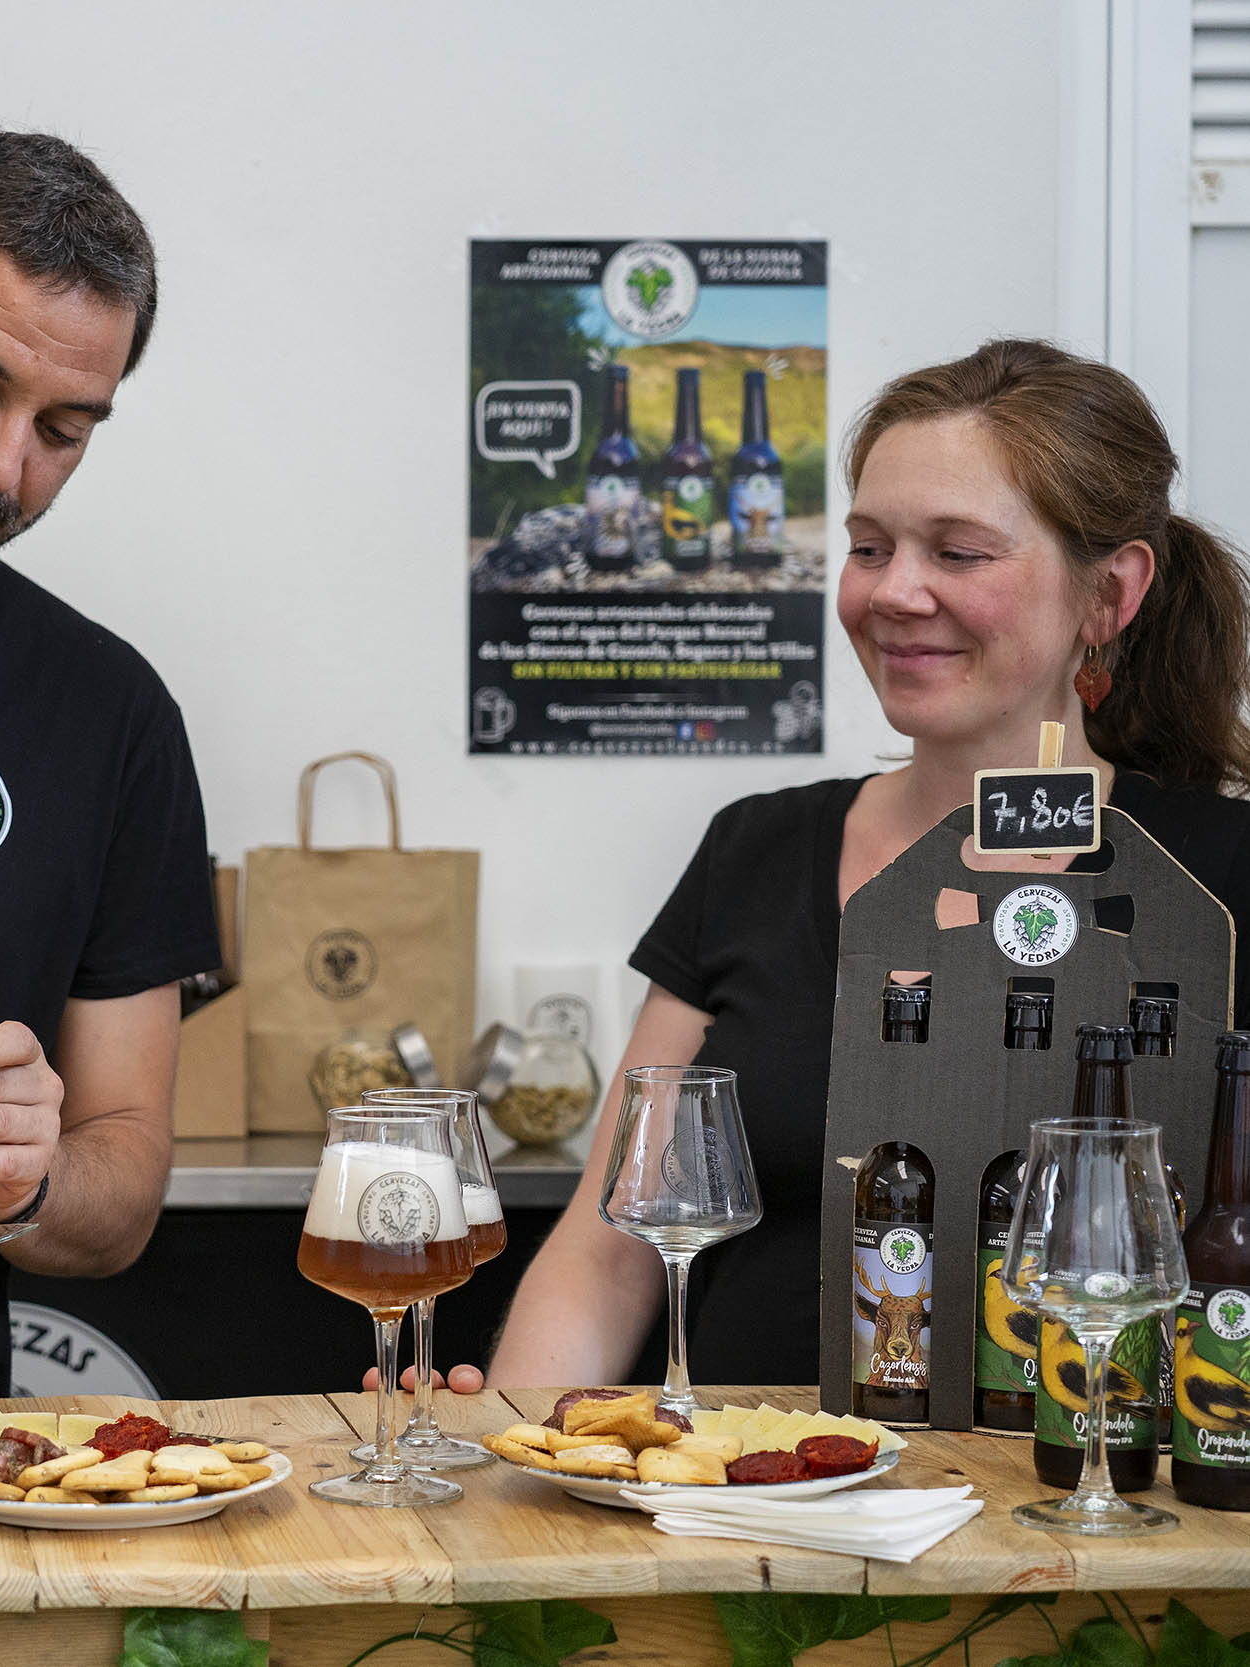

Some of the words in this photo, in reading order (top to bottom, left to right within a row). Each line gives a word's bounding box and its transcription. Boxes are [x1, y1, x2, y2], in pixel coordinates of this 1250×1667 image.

[987, 786, 1094, 834] 7,80€
[1017, 888, 1063, 905] CERVEZAS
[1002, 940, 1018, 956] LA
[1019, 947, 1061, 963] YEDRA
[378, 1176, 420, 1189] CERVEZAS
[890, 1230, 917, 1238] CERVEZAS
[886, 1260, 895, 1269] LA
[896, 1262, 920, 1272] YEDRA
[870, 1352, 928, 1377] Cazorlensis
